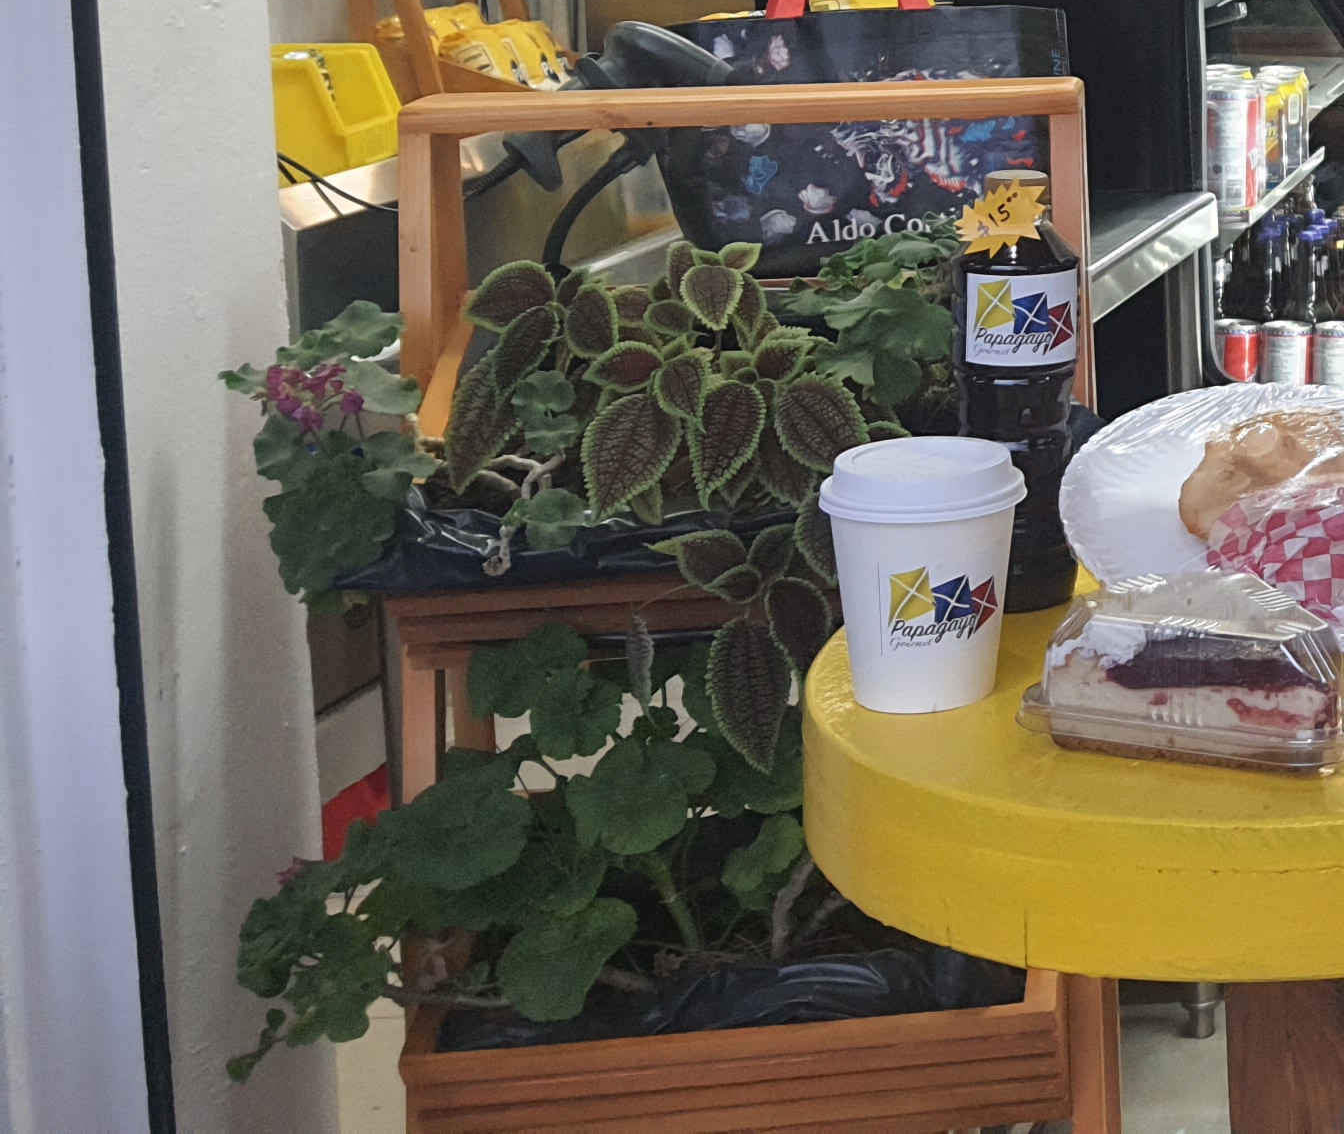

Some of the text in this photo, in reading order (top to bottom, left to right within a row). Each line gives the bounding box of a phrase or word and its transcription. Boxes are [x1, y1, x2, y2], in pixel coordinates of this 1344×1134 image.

[805, 217, 876, 245] Aldo
[975, 327, 1053, 354] Papagayo
[890, 612, 979, 643] Papagayo
